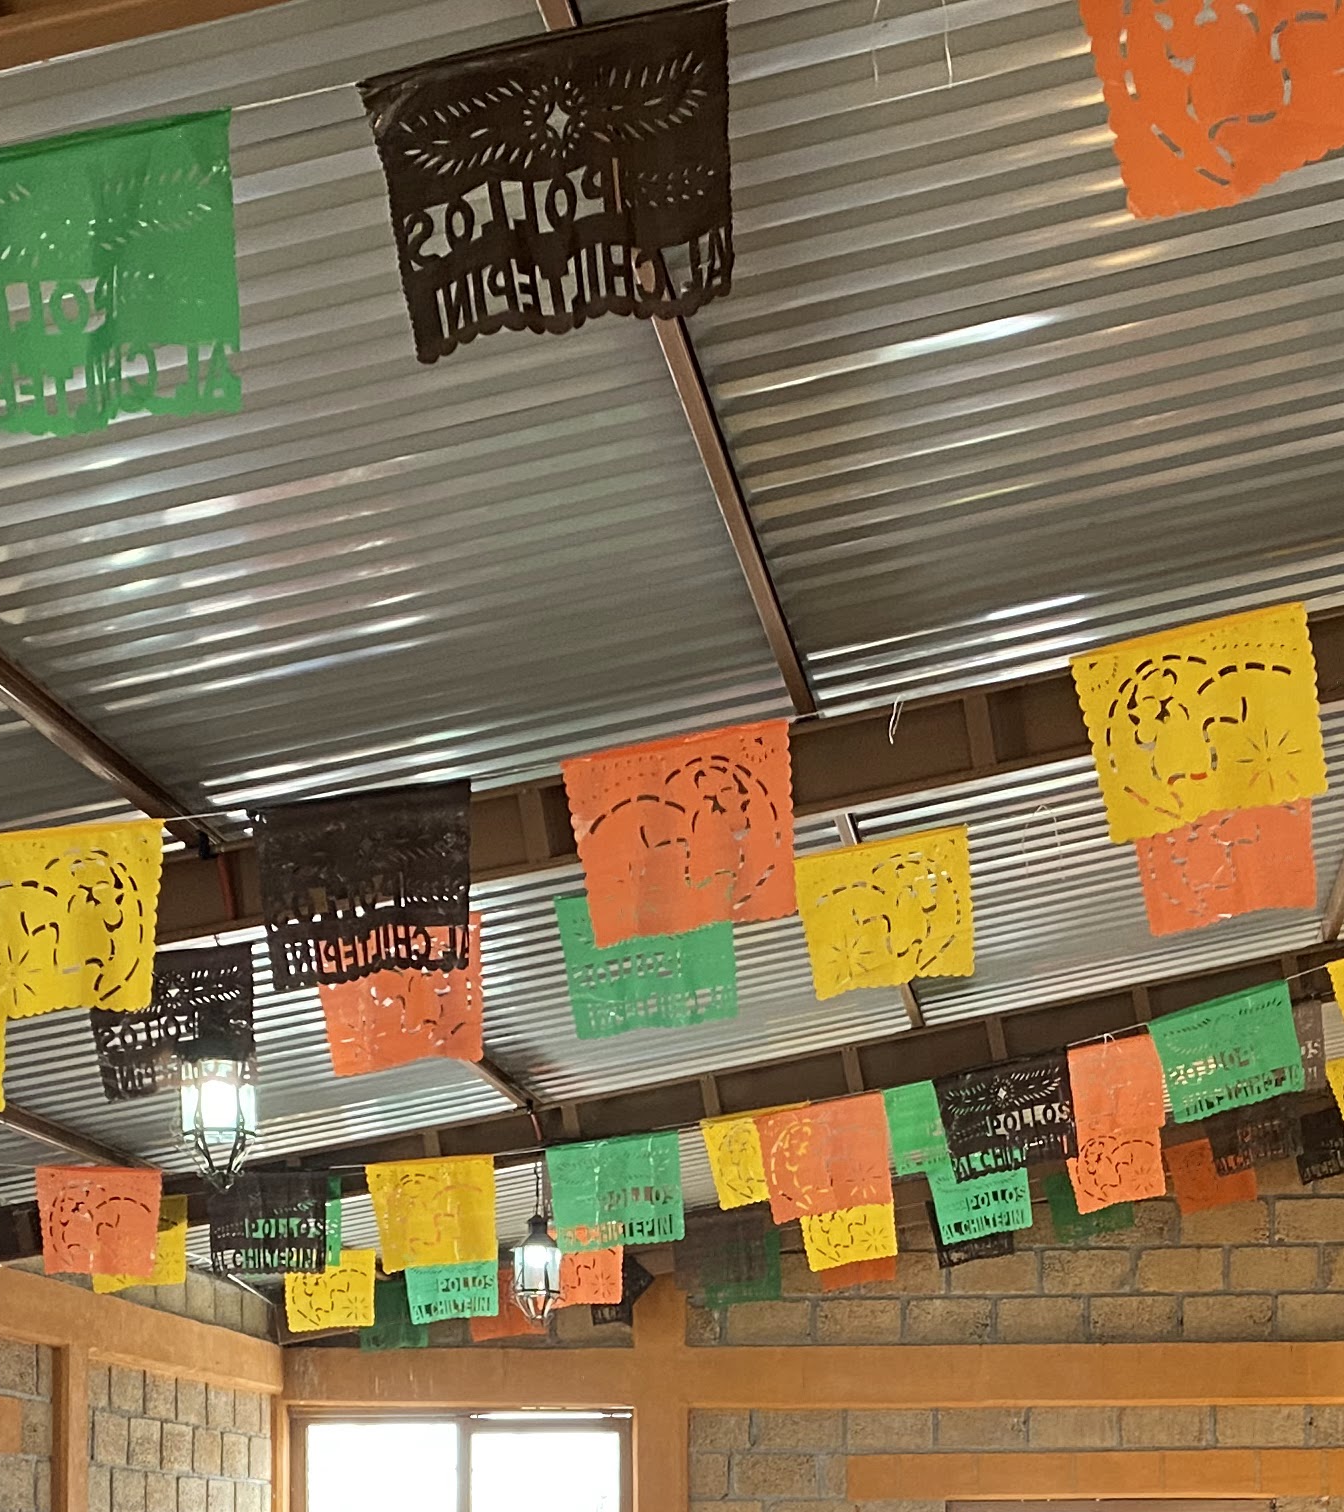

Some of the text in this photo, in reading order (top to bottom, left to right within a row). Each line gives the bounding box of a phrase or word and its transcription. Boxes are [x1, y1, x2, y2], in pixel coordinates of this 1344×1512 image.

[988, 1101, 1070, 1136] POLLOS
[967, 1187, 1027, 1211] POLLOS
[942, 1208, 1026, 1241] AL CHILTEPIN
[437, 1274, 495, 1294] POLLOS
